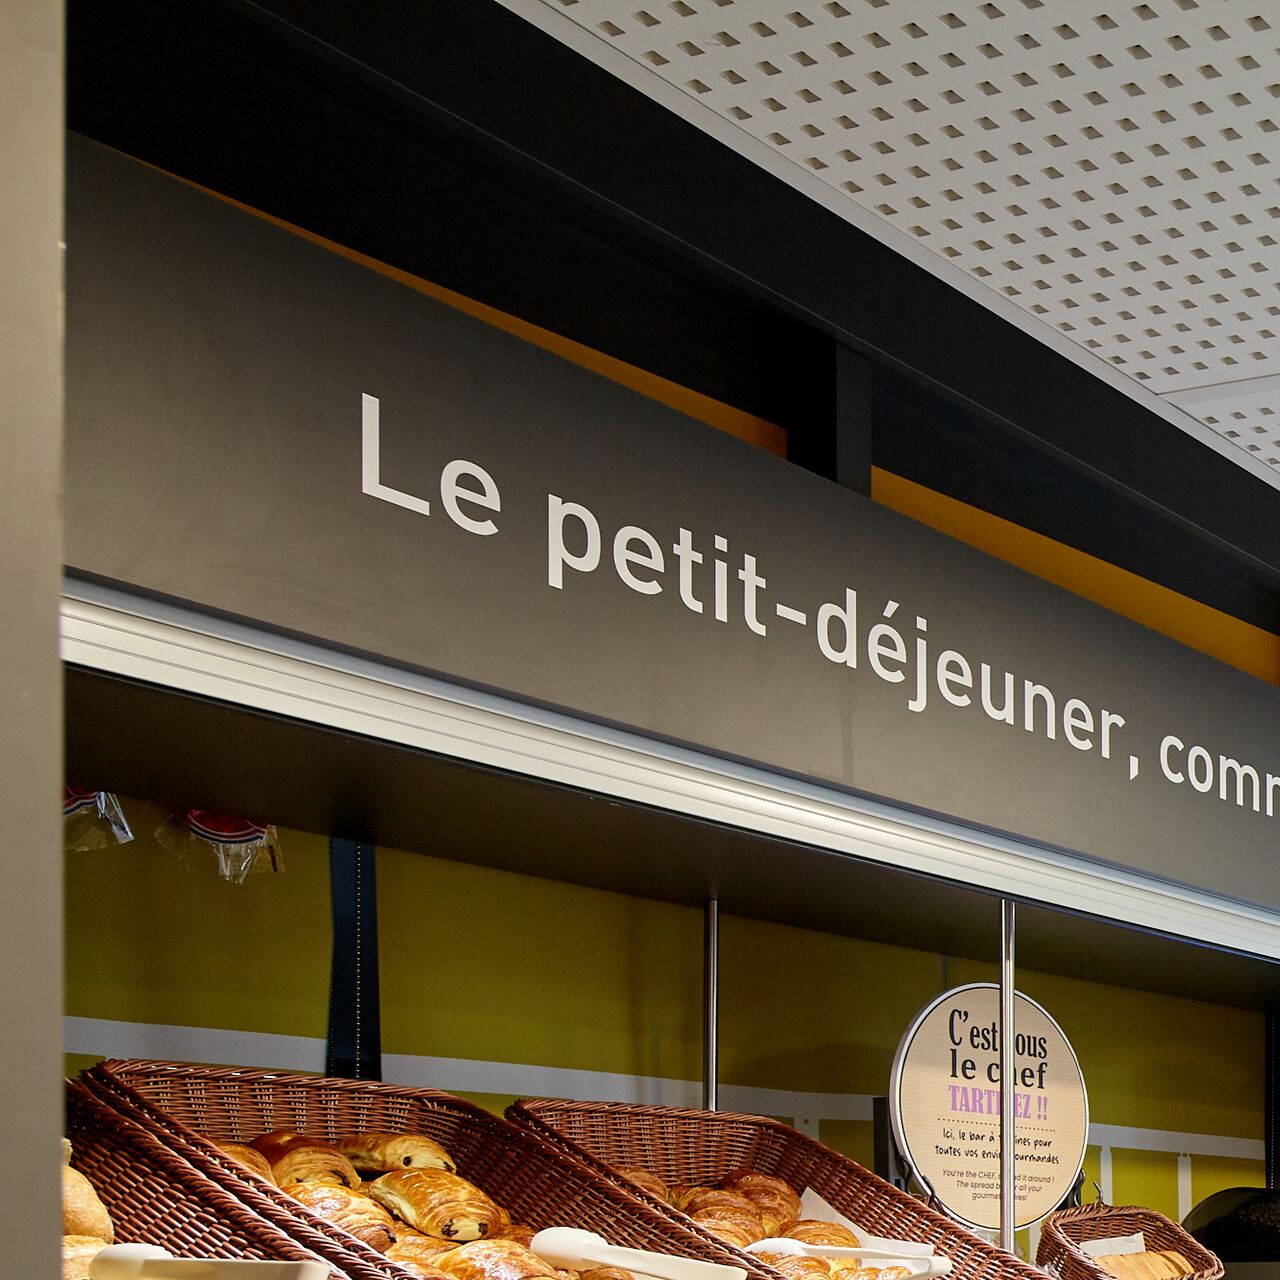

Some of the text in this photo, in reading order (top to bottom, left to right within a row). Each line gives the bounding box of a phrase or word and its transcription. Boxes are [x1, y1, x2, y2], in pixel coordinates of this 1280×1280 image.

[362, 392, 501, 536] Le
[547, 492, 1140, 781] petit-déjeuner,
[949, 1008, 1048, 1059] C'est ous
[949, 1048, 1049, 1090] le cef
[948, 1084, 1048, 1121] TARTIEZ !!
[942, 1127, 956, 1141] Ici,
[959, 1129, 967, 1141] le
[969, 1130, 987, 1142] bar
[988, 1130, 996, 1142] à
[1033, 1138, 1053, 1150] pour
[934, 1144, 1060, 1165] toutes vos envi ourmandes
[956, 1180, 969, 1188] The
[970, 1181, 995, 1191] spread
[1019, 1183, 1028, 1191] all
[1028, 1184, 1043, 1194] your
[965, 1170, 978, 1178] the
[978, 1171, 997, 1180] CHEF,
[1028, 1174, 1052, 1183] around
